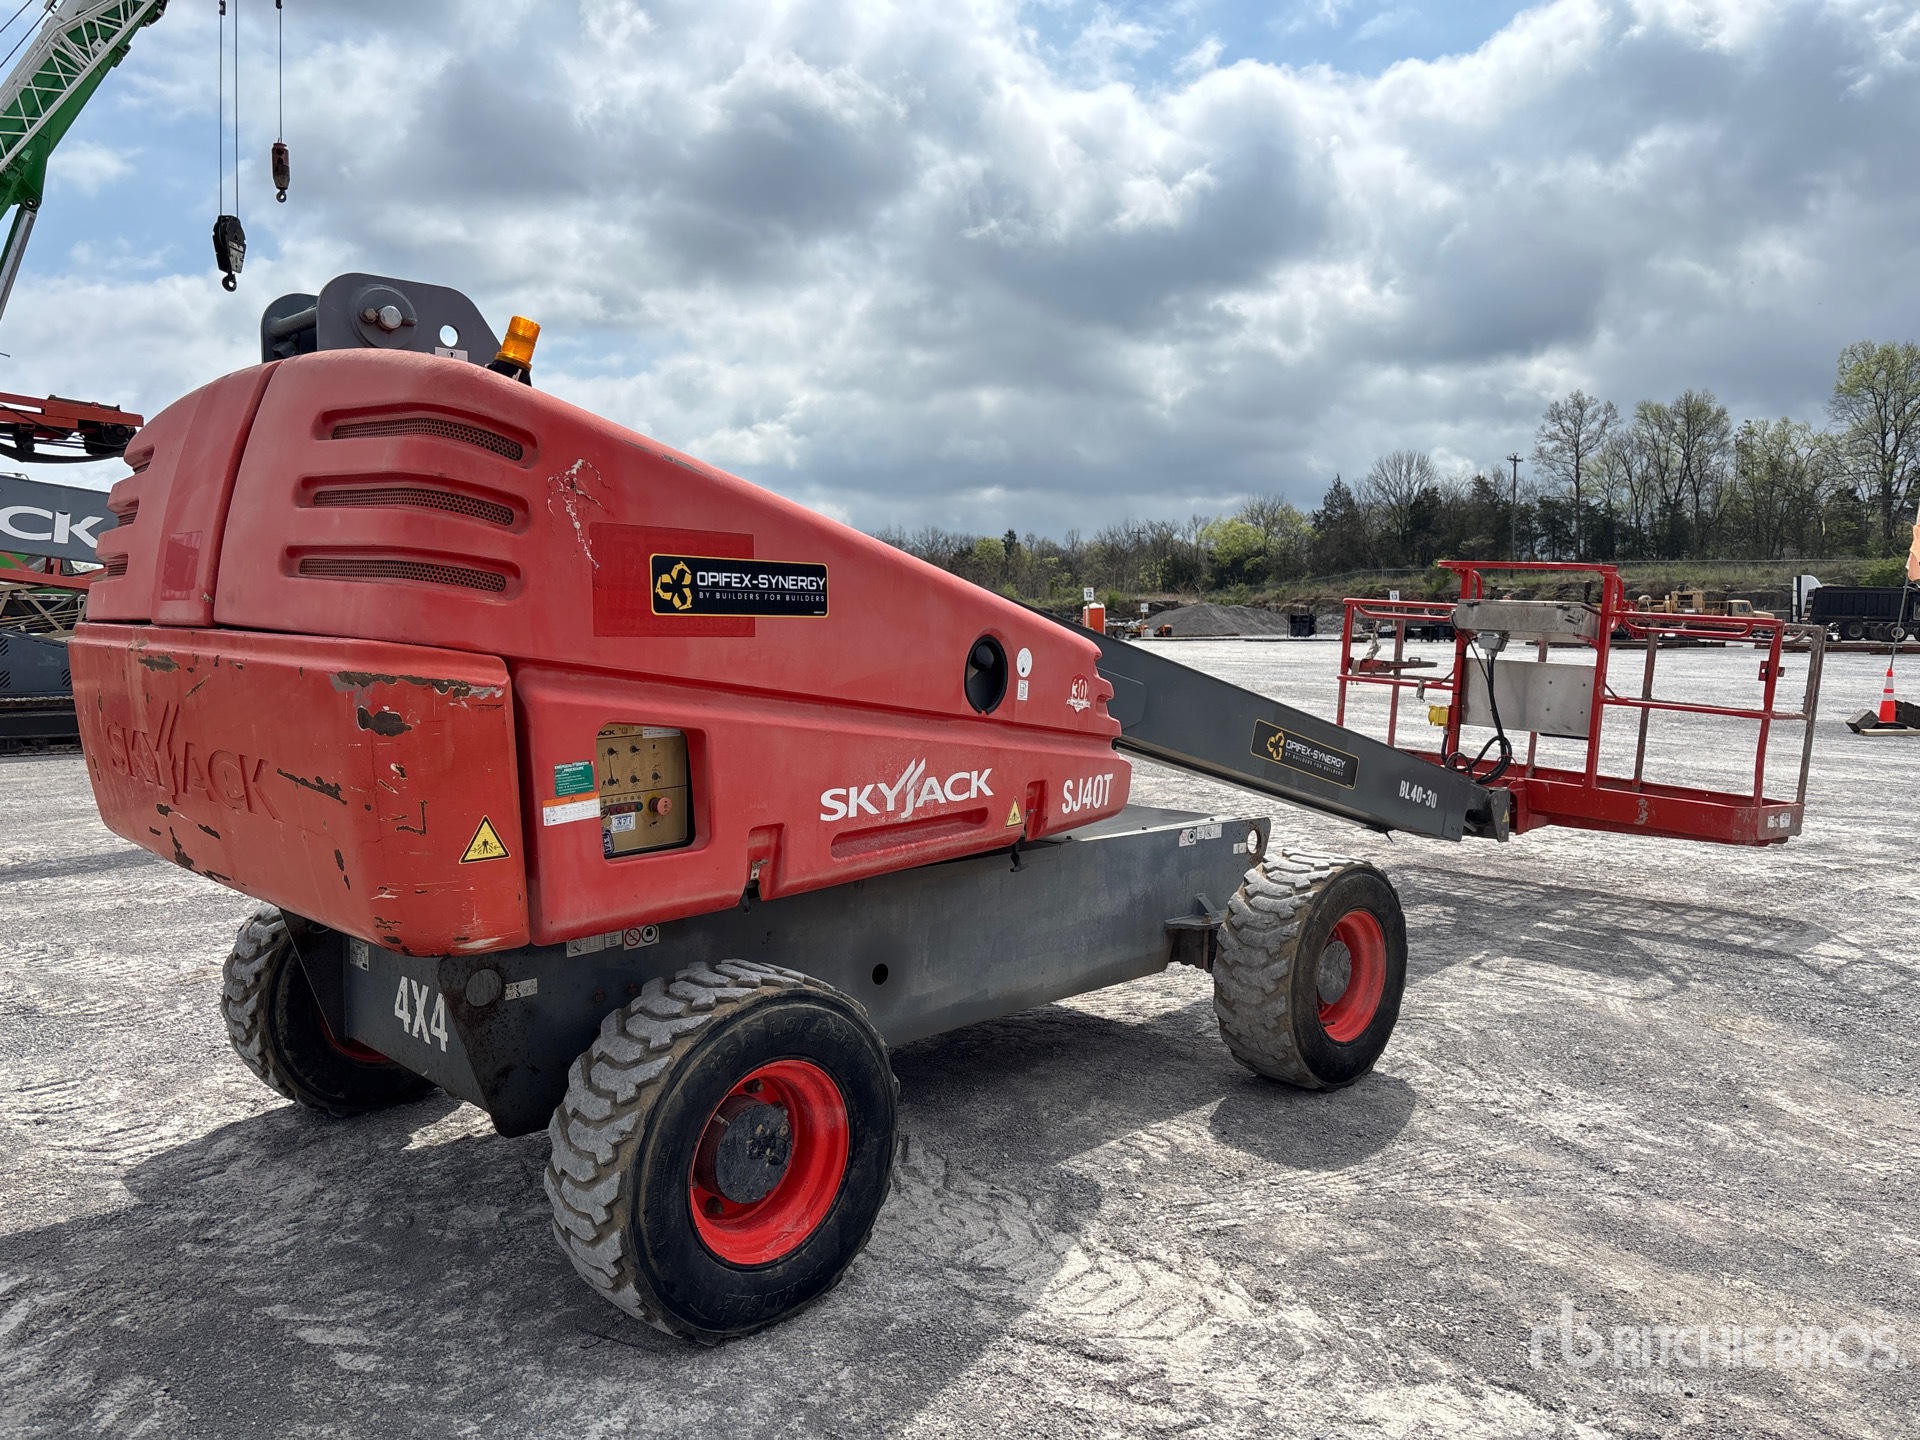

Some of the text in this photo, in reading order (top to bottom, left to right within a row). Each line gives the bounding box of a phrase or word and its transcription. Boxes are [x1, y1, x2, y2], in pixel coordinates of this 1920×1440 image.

[0, 506, 104, 549] CK
[697, 571, 826, 590] OPIFEX-SYNERGY
[699, 591, 825, 602] BY BUILDERS FOR BUILDERS
[106, 701, 285, 824] SKYJACK
[1285, 739, 1346, 769] OPIFEX-SYNERGY
[820, 757, 994, 822] SKYJACK
[1062, 773, 1113, 814] SJ40T
[1399, 780, 1437, 808] BL40-30
[394, 975, 448, 1052] 4X4
